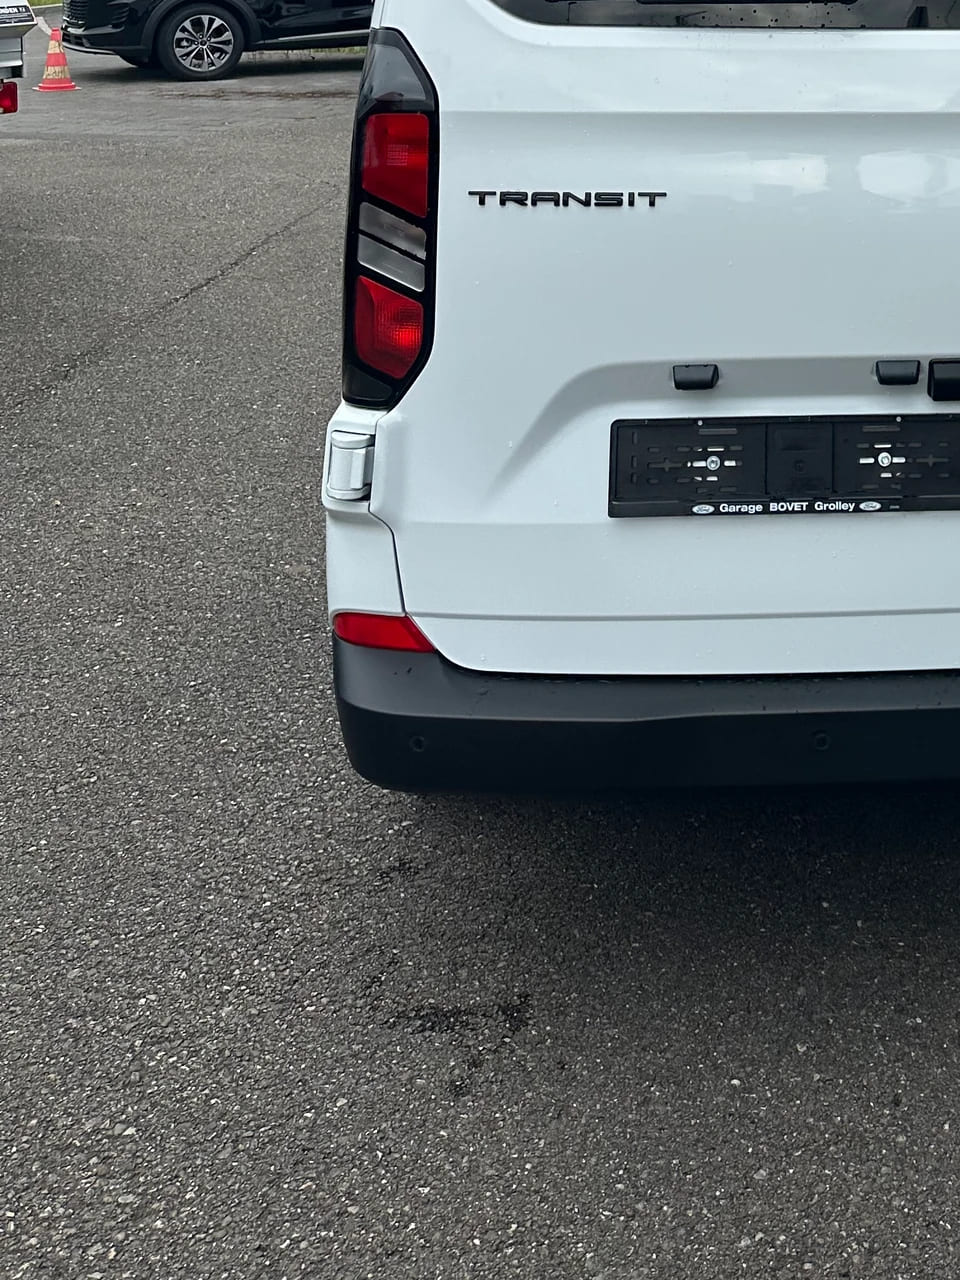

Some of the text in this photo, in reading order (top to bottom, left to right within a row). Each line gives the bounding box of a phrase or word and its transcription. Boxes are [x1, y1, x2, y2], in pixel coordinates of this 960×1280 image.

[468, 190, 667, 207] TRANSIT
[719, 503, 763, 513] Garage
[769, 502, 809, 512] BOVET
[814, 501, 855, 512] Grolley
